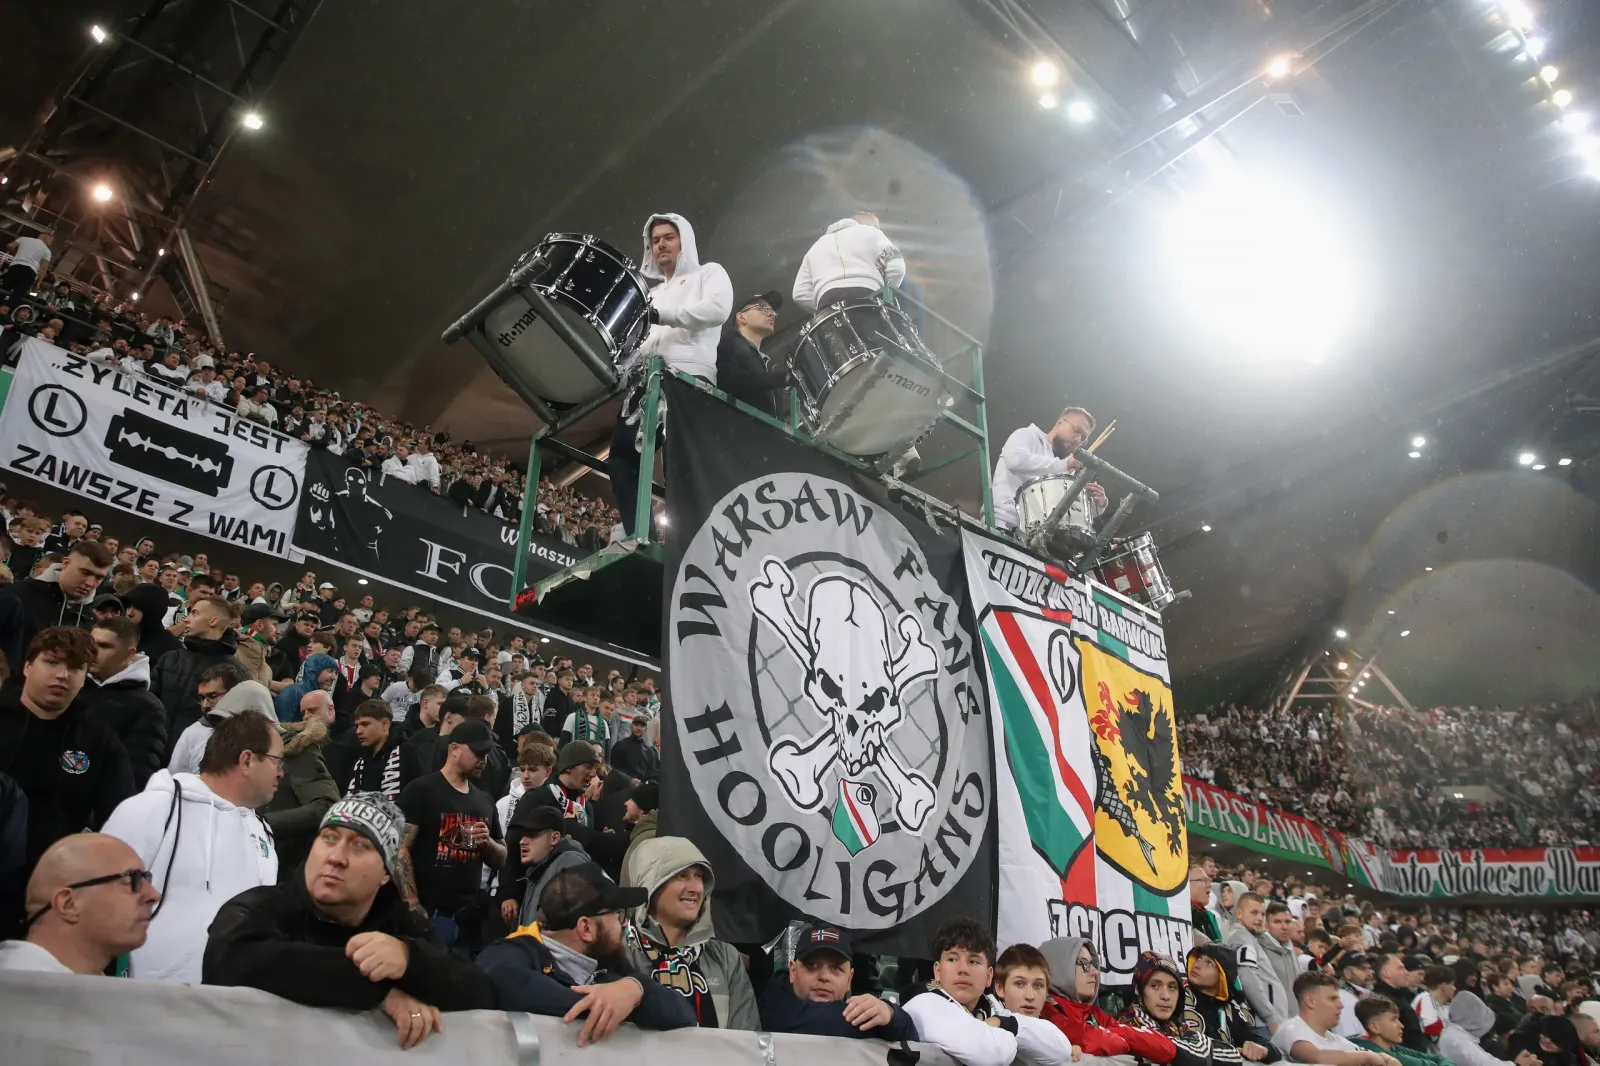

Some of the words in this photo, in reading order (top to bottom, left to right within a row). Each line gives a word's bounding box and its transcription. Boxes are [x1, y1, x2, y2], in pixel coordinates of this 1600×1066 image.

[9, 443, 163, 517] ZAWSZE
[168, 500, 195, 527] Z
[208, 511, 287, 555] WAMI
[213, 411, 291, 453] JEST
[676, 479, 874, 646] WARSAW
[683, 699, 985, 923] HOOLIGANS
